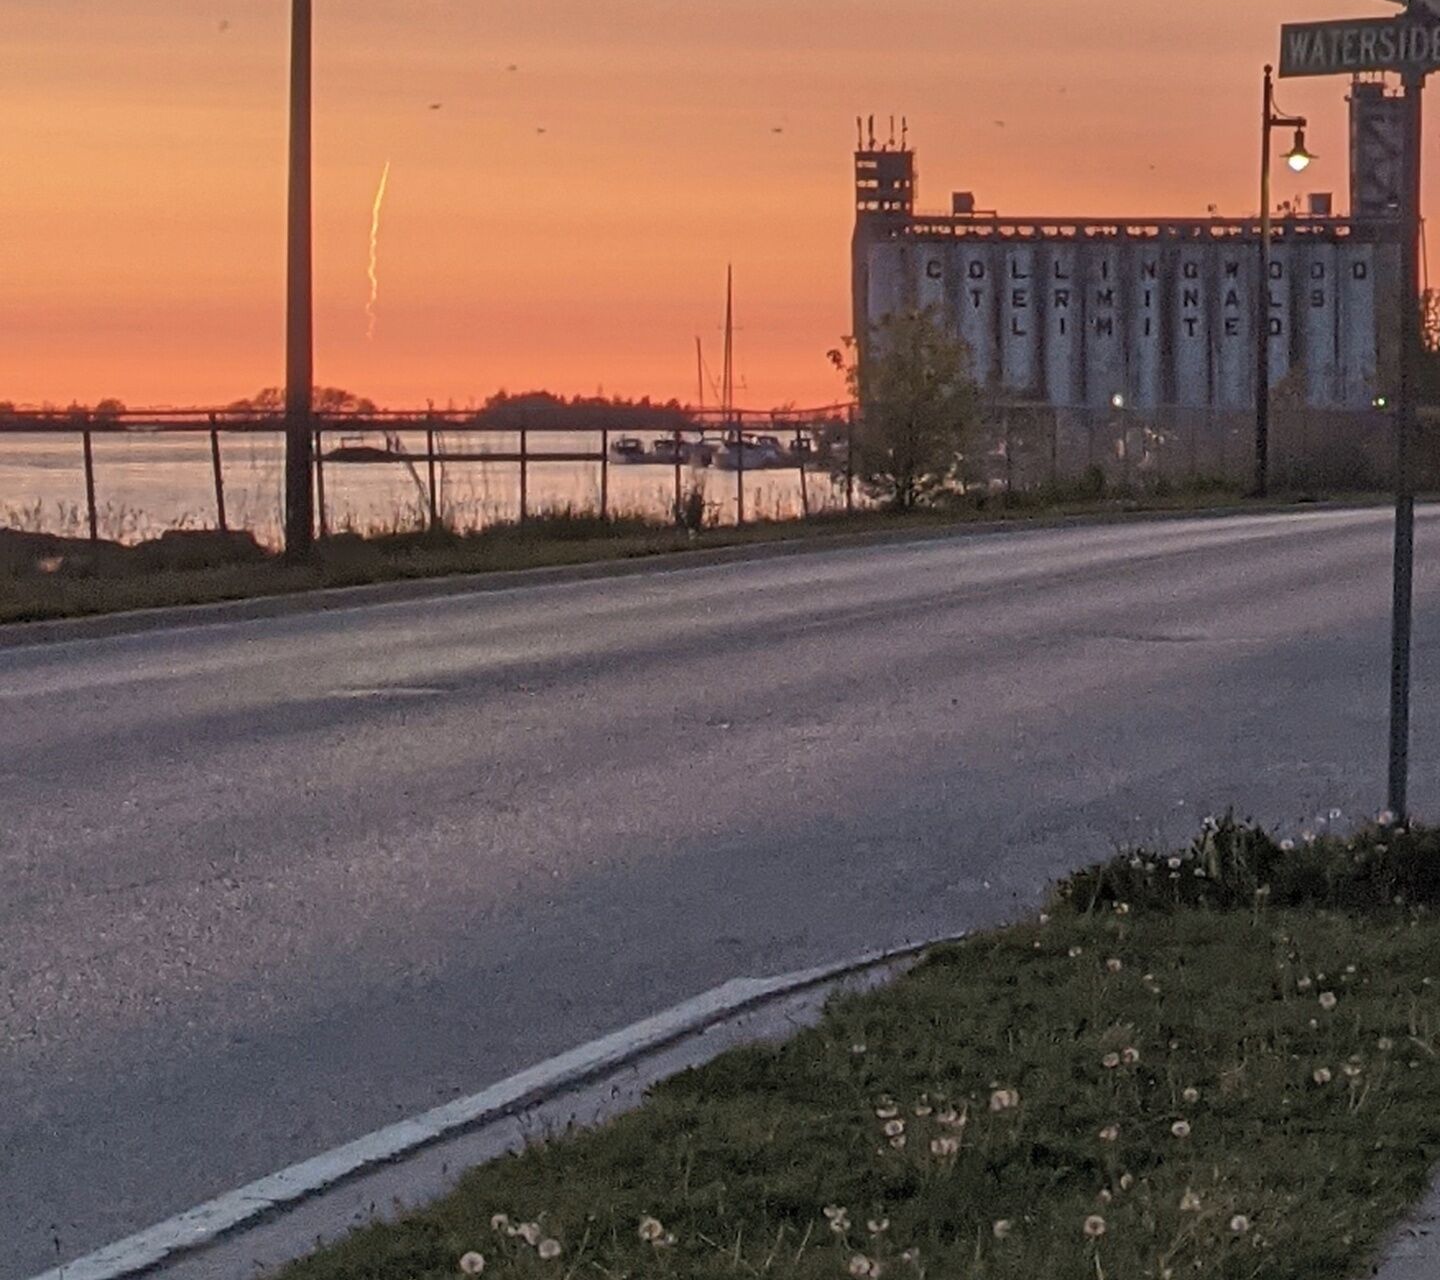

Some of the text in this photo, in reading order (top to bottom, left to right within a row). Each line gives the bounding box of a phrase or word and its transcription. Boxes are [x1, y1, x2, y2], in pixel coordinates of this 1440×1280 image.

[926, 259, 1367, 280] COLLINGWOOD
[969, 288, 1325, 308] TERMINALS
[1011, 316, 1282, 337] LIMITED
